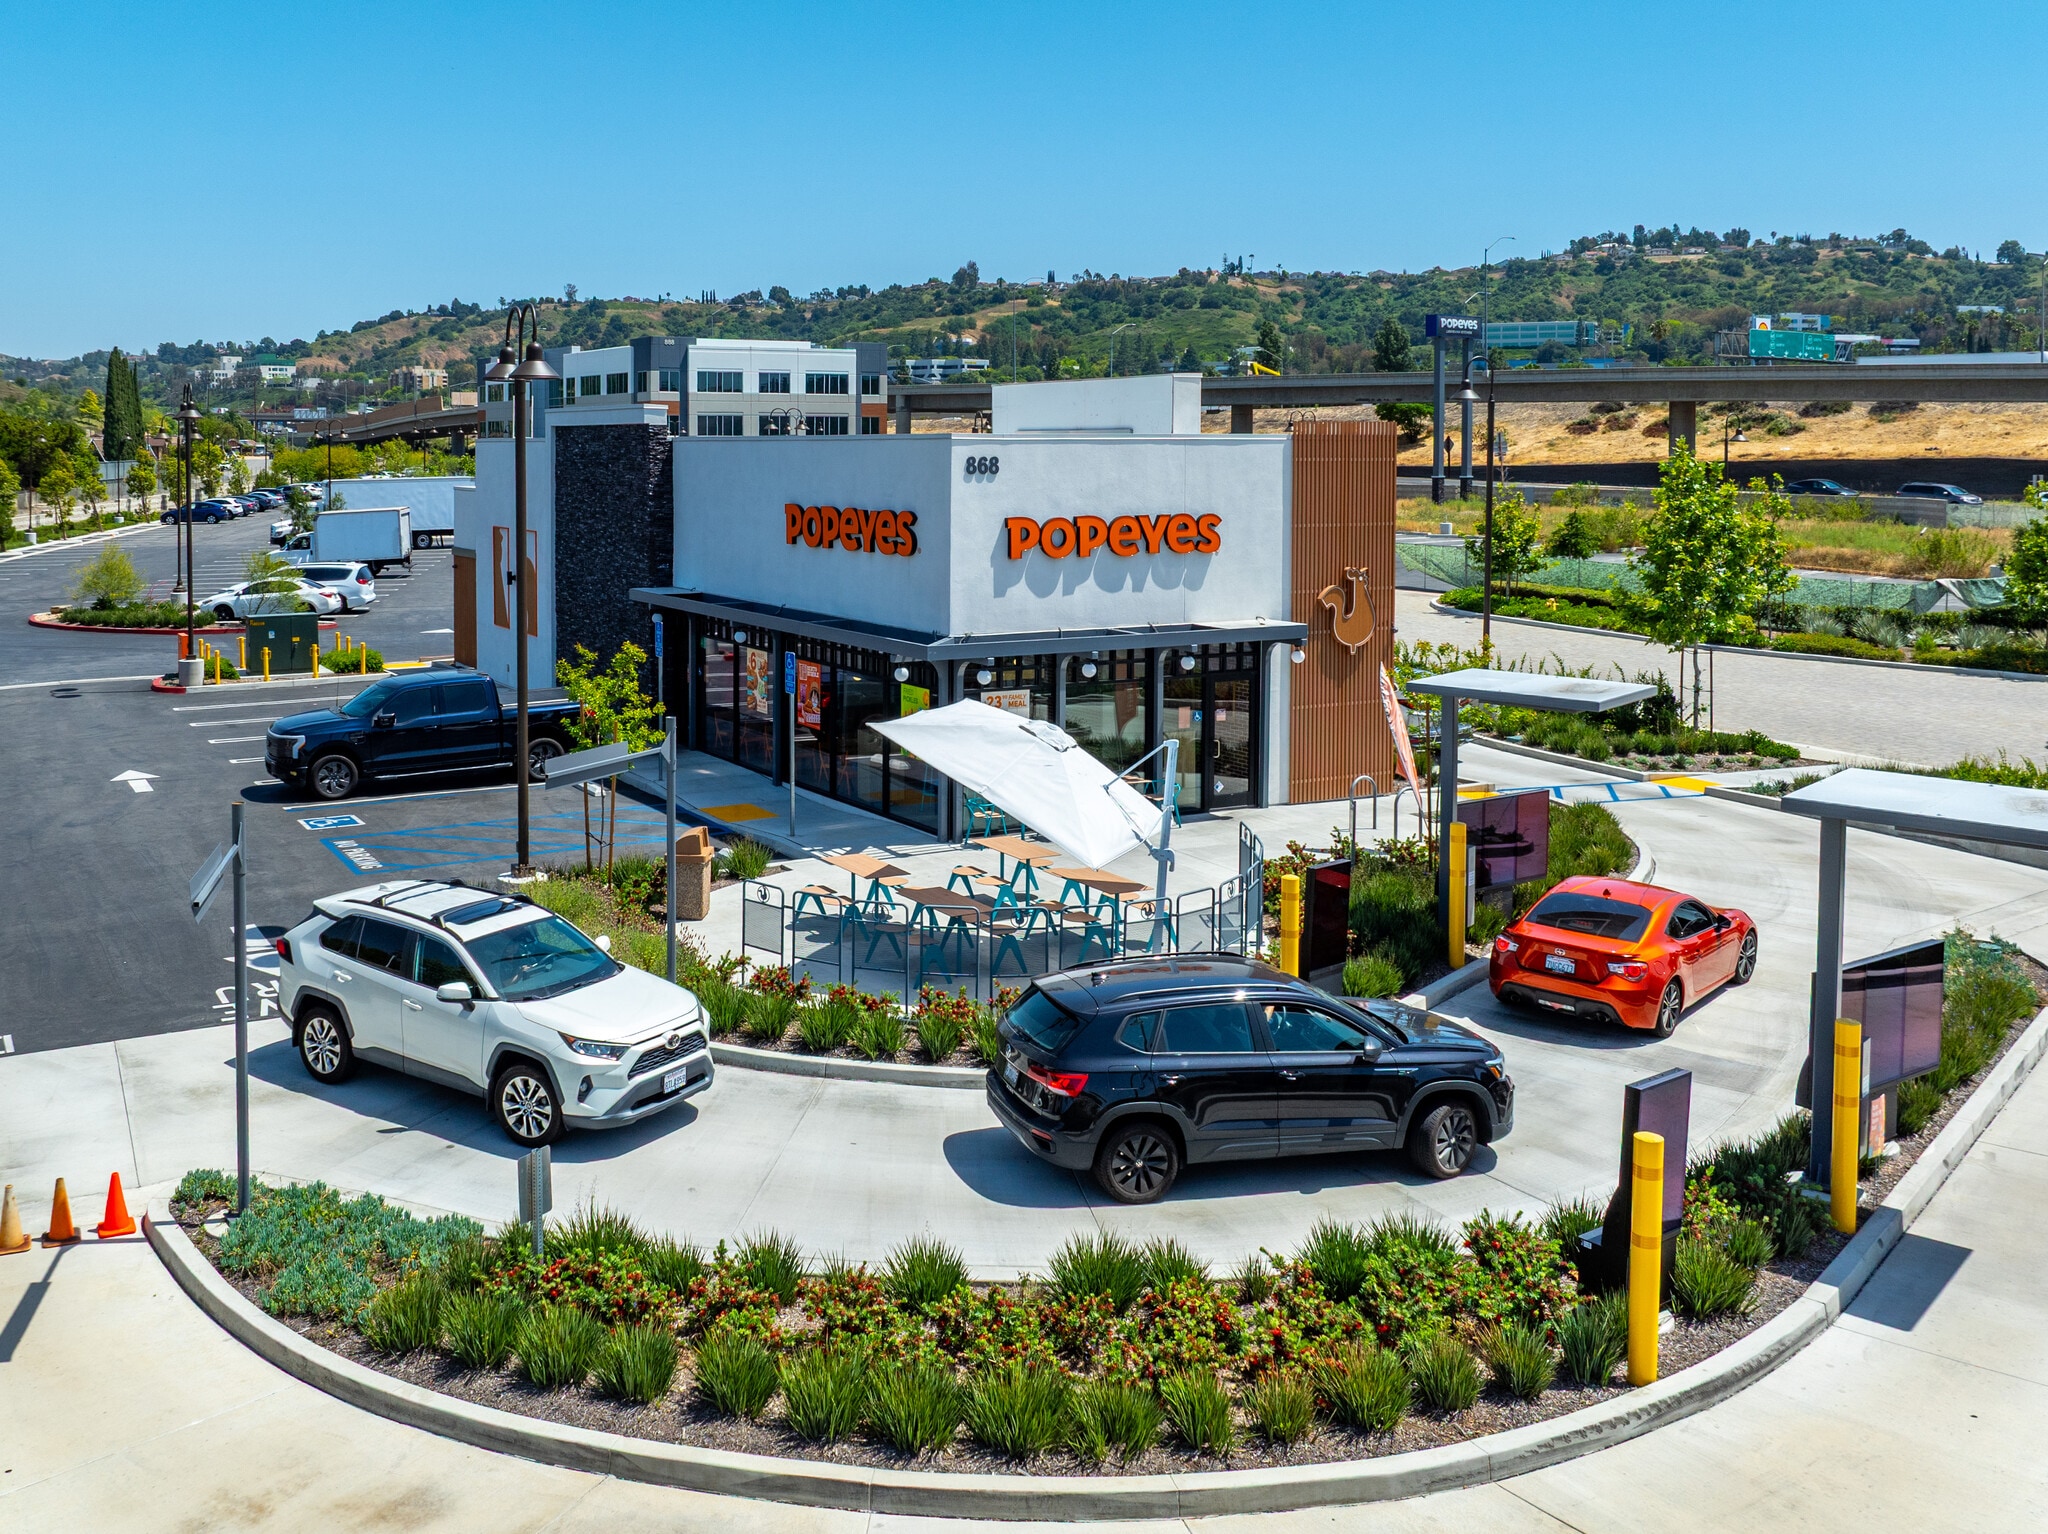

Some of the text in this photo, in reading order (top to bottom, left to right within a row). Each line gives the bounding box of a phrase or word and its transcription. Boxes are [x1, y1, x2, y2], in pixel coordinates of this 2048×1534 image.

[966, 456, 1000, 475] 868
[1008, 700, 1027, 708] MEAL
[342, 848, 384, 870] PARKING
